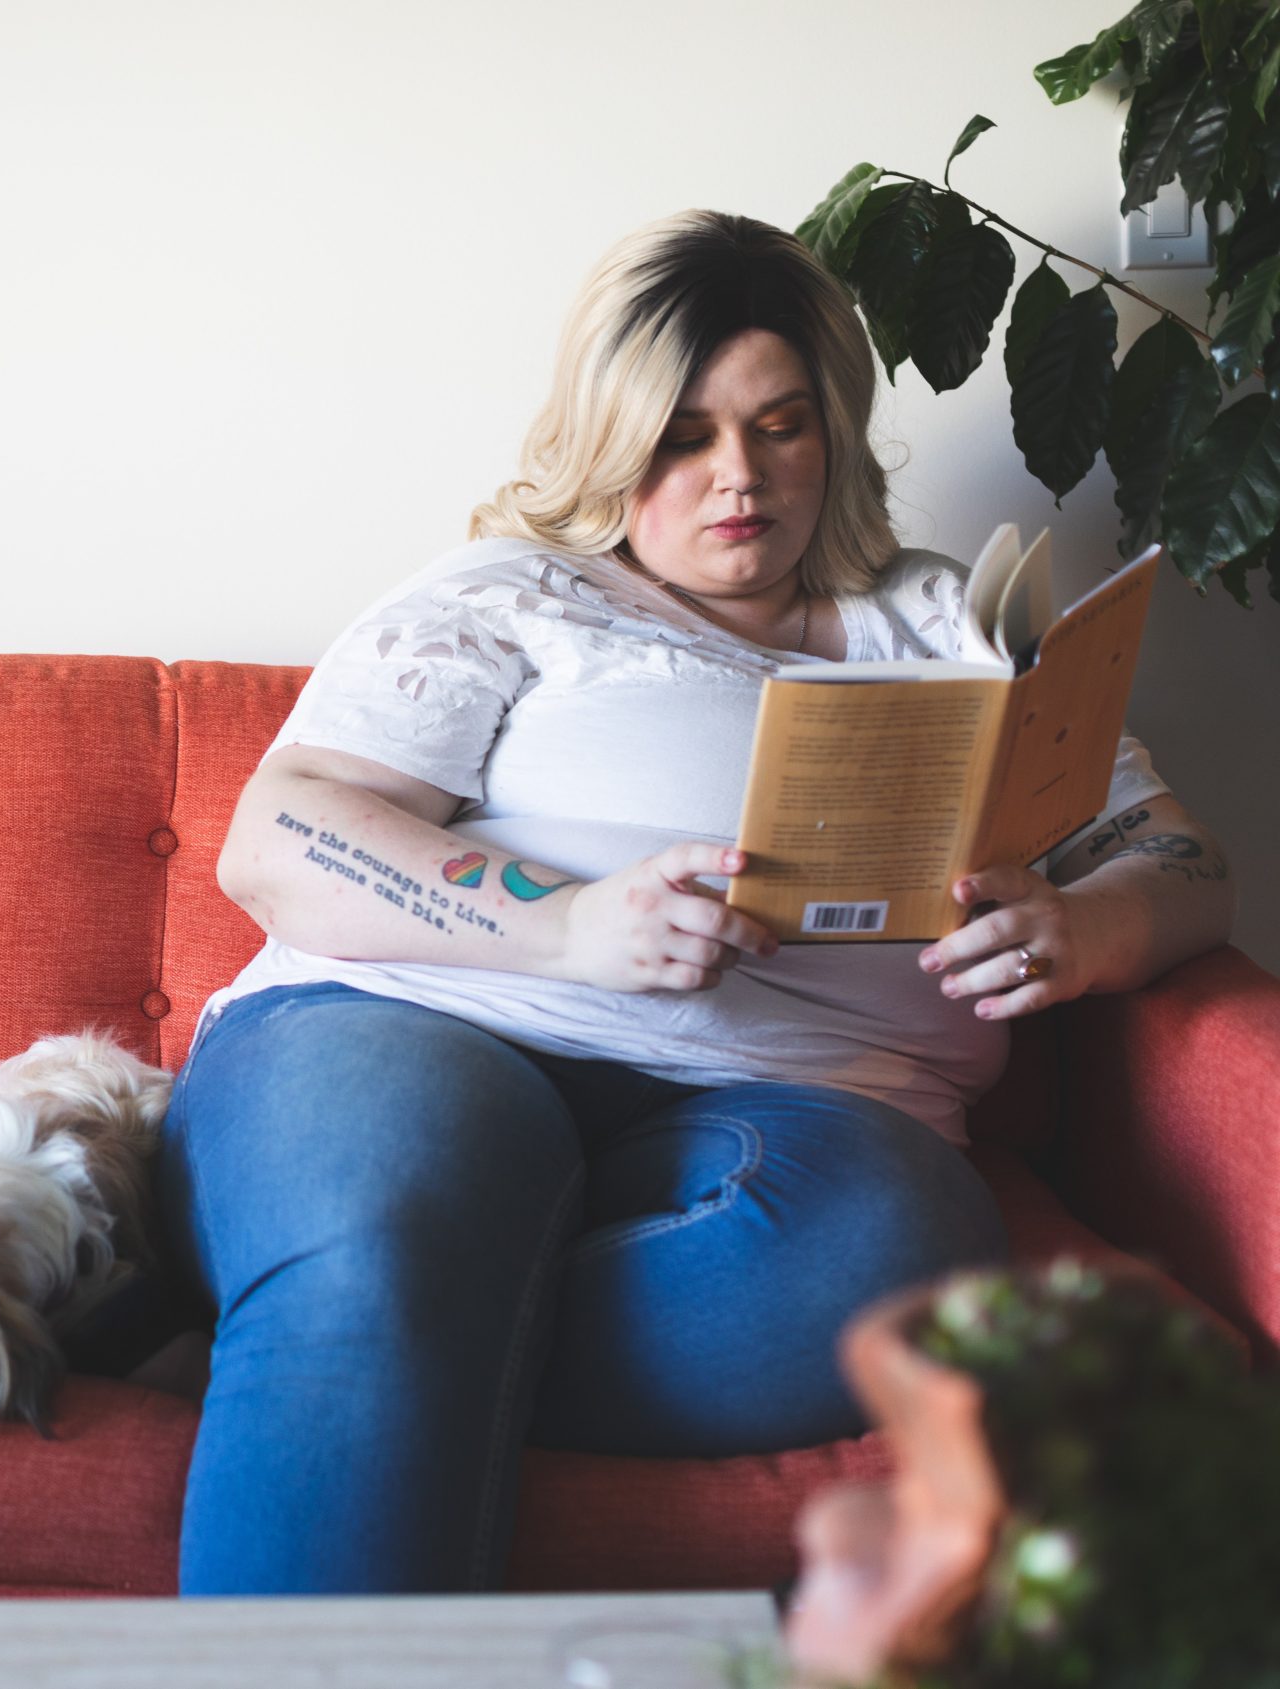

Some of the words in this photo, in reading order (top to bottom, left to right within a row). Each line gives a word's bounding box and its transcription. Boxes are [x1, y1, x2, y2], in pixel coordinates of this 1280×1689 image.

[275, 812, 313, 837] Have
[318, 831, 348, 853] the
[352, 848, 422, 896] courage
[430, 888, 450, 909] to
[455, 902, 504, 936] Live.
[304, 845, 367, 886] Anyone
[373, 882, 405, 909] can
[411, 901, 453, 935] Die.
